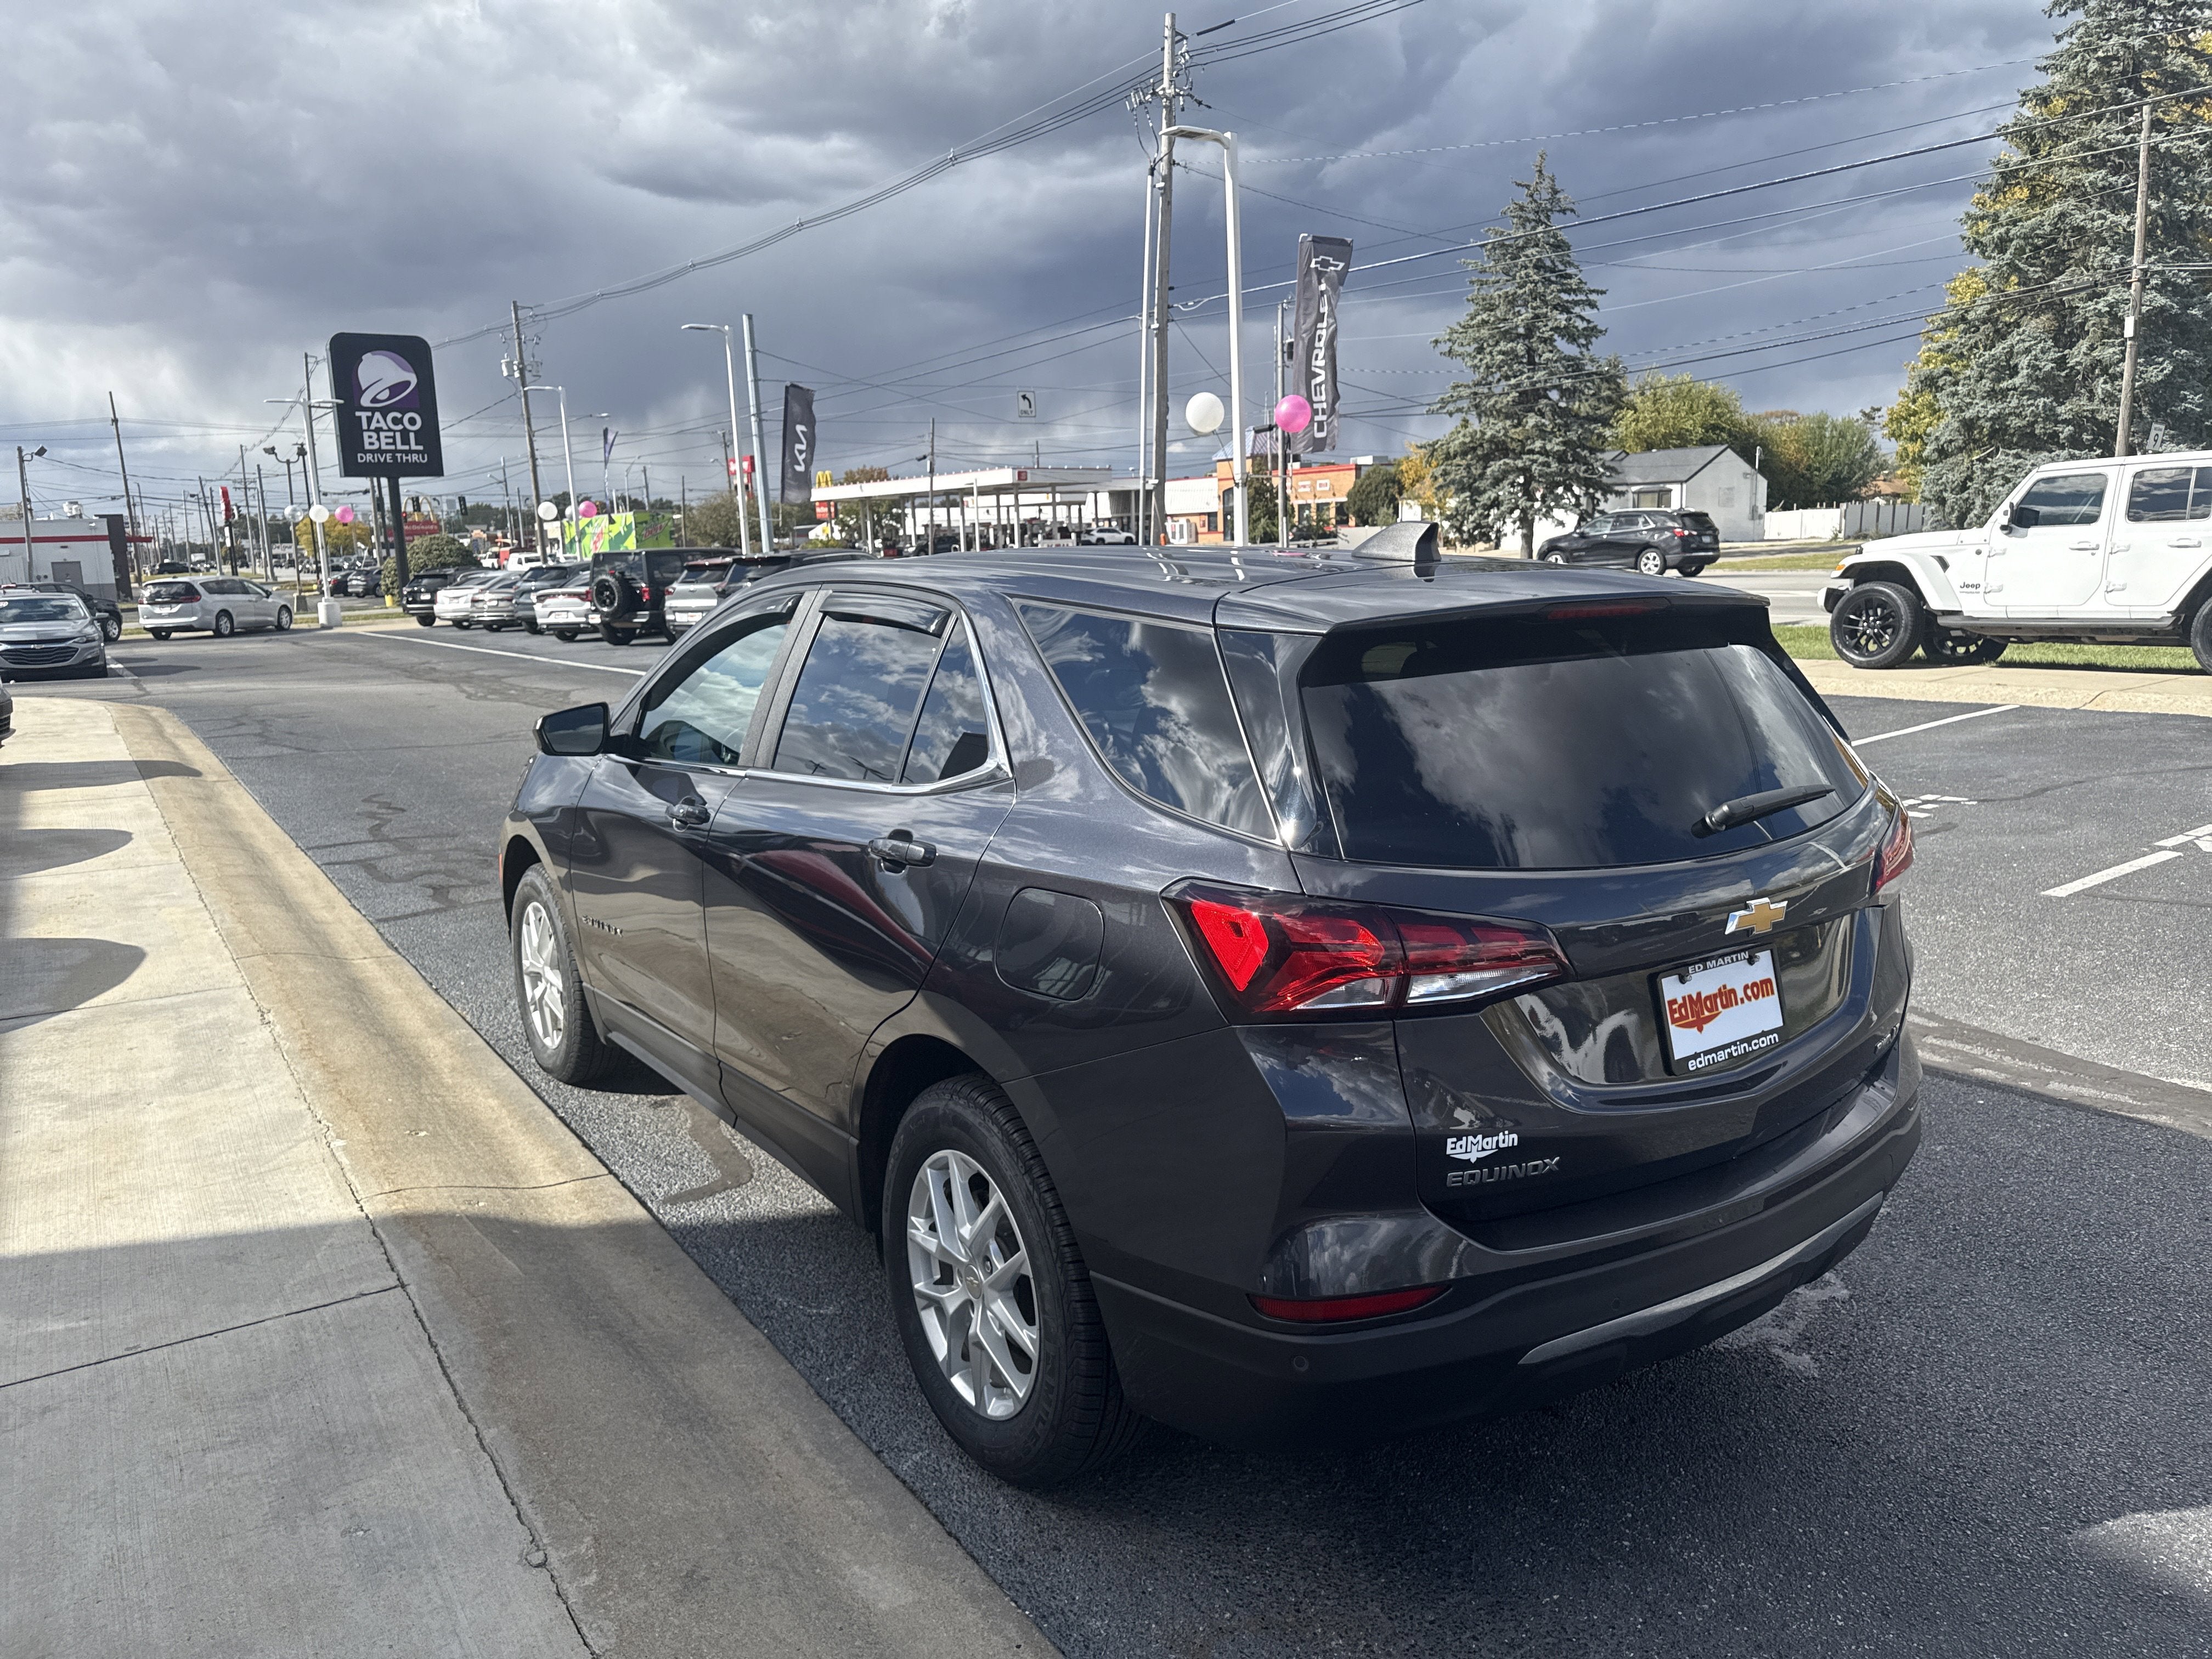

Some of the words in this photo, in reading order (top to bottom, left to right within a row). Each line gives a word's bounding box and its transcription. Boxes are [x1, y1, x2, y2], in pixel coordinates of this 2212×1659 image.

[355, 411, 422, 431] TACO
[363, 431, 424, 450] BELL
[2153, 433, 2159, 448] 9
[357, 453, 393, 463] DRIVE
[395, 453, 428, 463] THRU
[1960, 582, 1980, 590] Jeep
[1688, 964, 1703, 974] ED
[1706, 951, 1749, 969] MARTIN
[1667, 977, 1775, 1026] EdMartin.com
[1688, 1033, 1779, 1071] edmartin.com
[1446, 1130, 1518, 1155] EdMartin
[1447, 1156, 1560, 1187] EQUINOX
